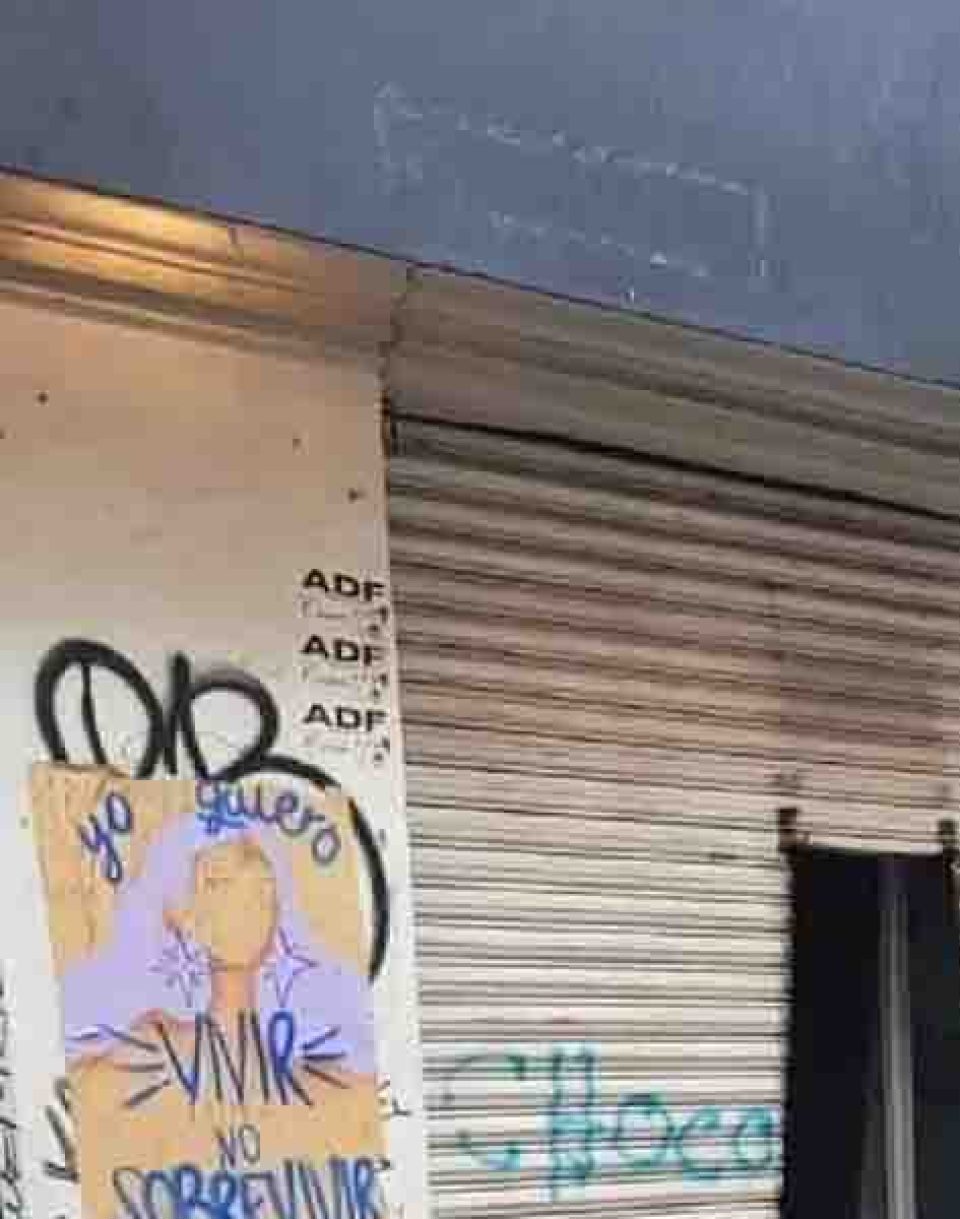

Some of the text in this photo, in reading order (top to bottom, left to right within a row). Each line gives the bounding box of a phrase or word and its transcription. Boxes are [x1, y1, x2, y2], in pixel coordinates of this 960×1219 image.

[302, 568, 386, 601] ADF
[302, 634, 386, 666] ADF
[303, 703, 388, 732] ADF
[153, 1009, 315, 1107] VIVIR
[212, 1123, 261, 1169] NO
